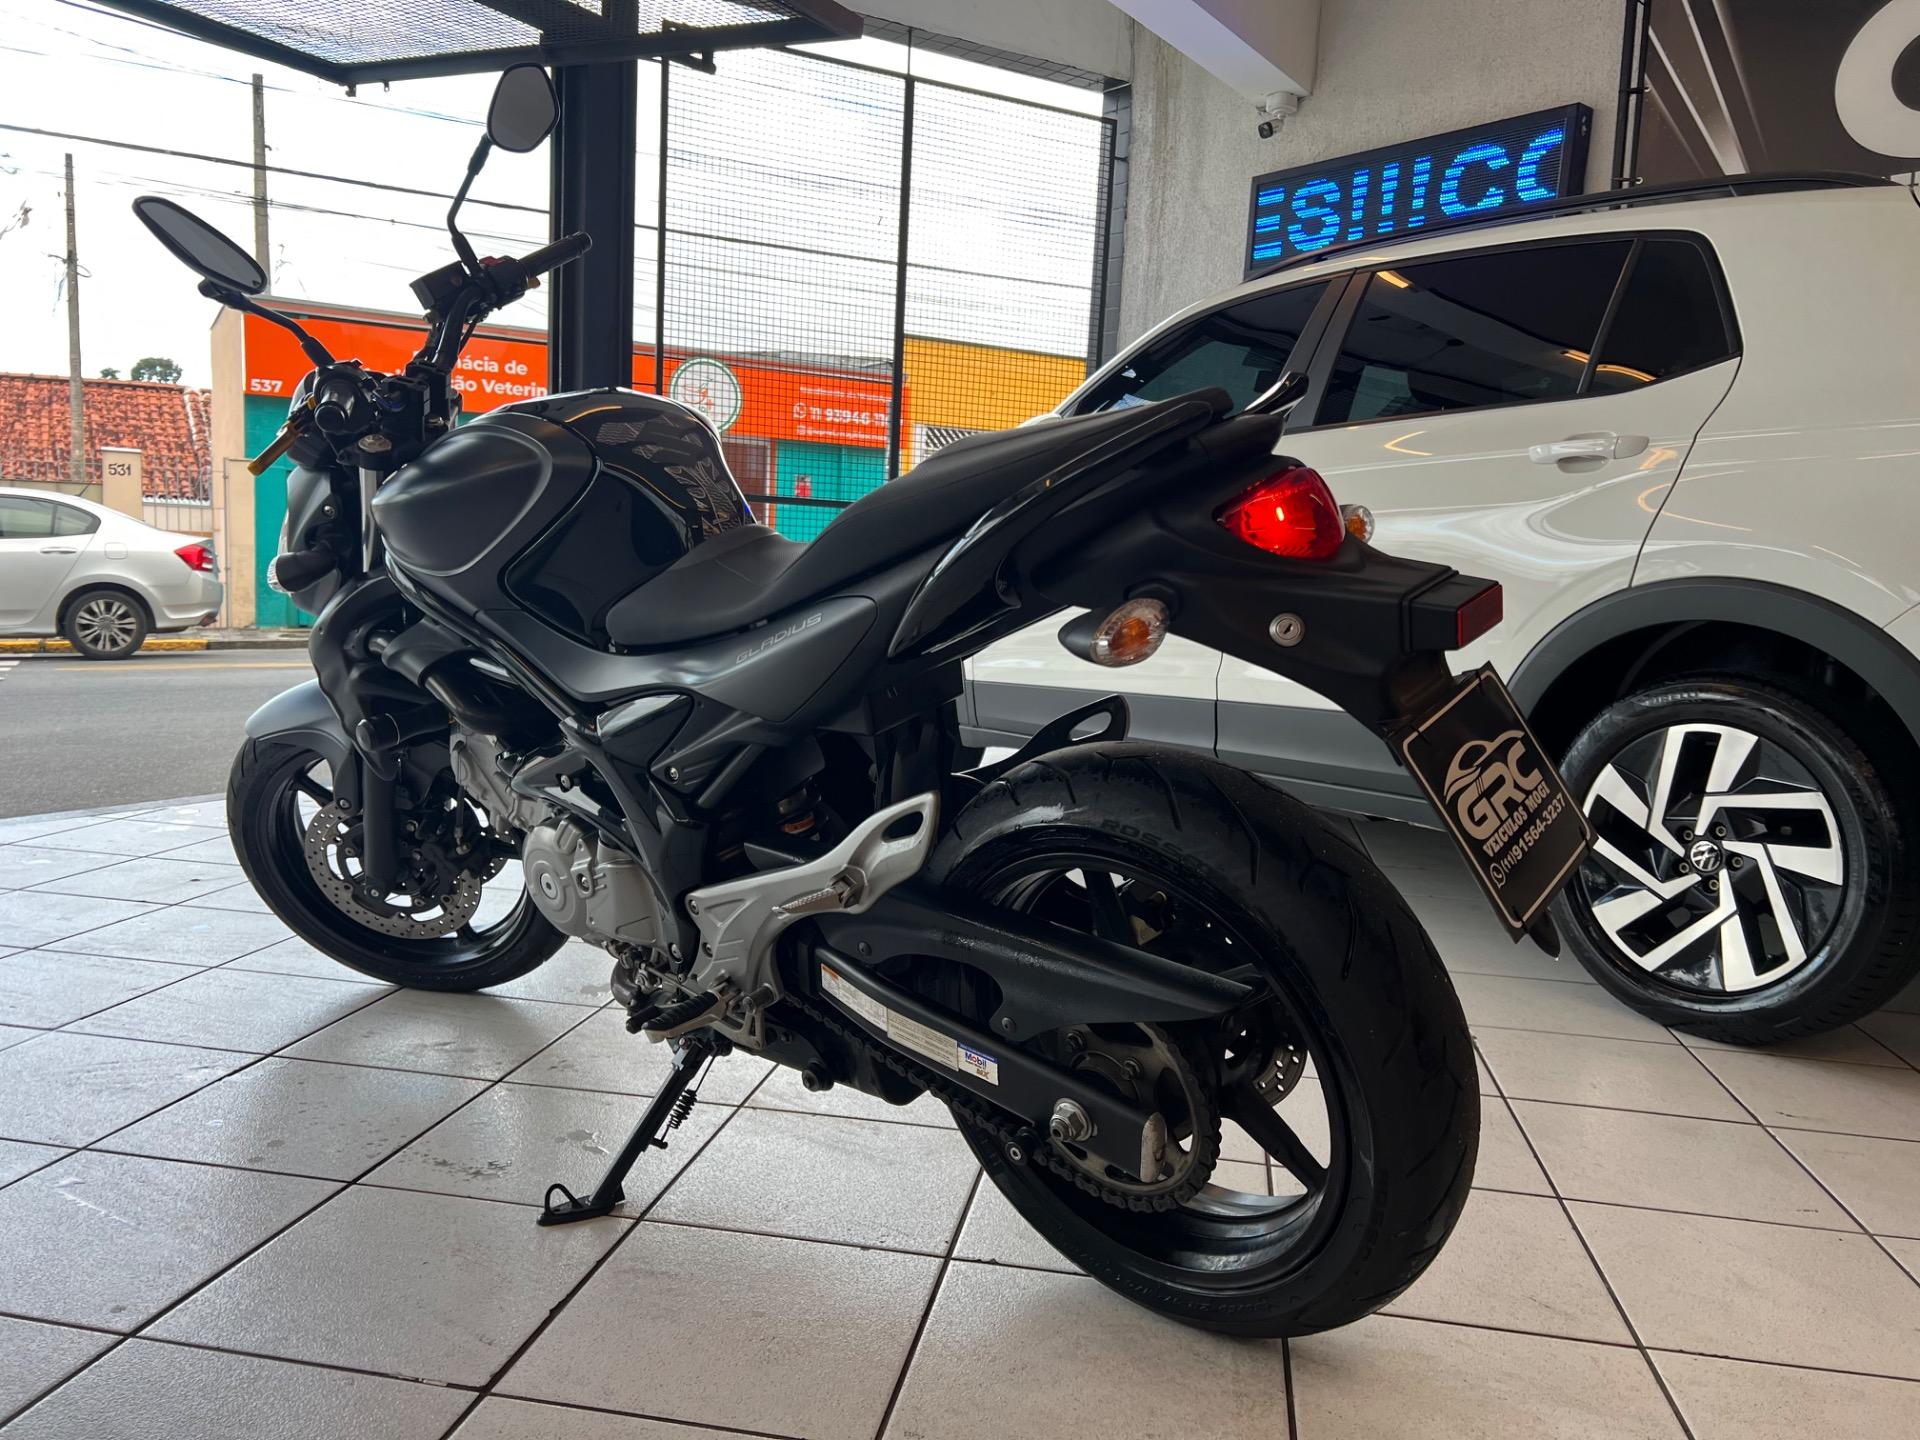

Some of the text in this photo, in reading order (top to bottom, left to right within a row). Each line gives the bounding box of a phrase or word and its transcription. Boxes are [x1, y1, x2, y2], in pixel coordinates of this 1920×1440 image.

[504, 357, 528, 376] de
[250, 378, 283, 393] 537
[481, 378, 548, 397] Veterin
[107, 462, 132, 476] 531
[736, 612, 823, 665] GLADIUS
[1457, 740, 1544, 840] GRC
[1482, 781, 1551, 858] VEICULOS MOGI
[965, 1051, 987, 1070] Mobil
